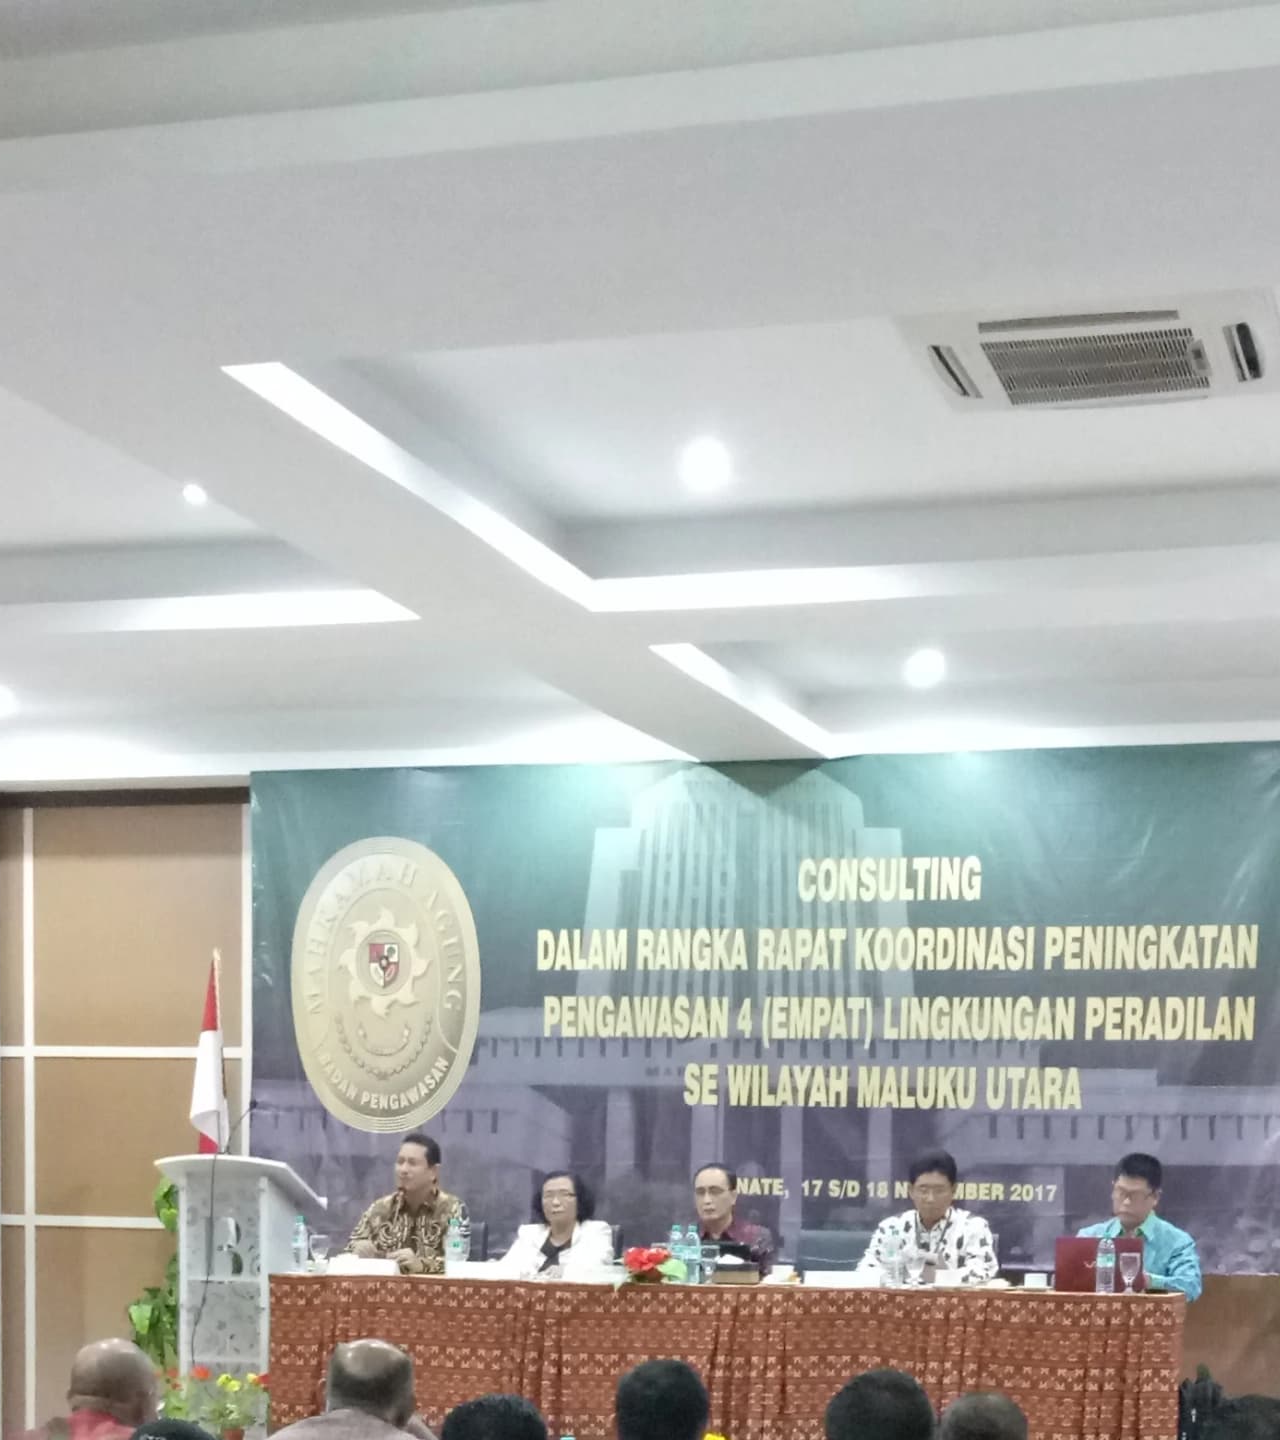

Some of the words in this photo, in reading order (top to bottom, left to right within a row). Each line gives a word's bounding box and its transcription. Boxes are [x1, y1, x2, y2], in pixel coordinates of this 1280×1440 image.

[797, 856, 982, 902] CONSULTING
[427, 889, 465, 1011] AGUNG
[537, 928, 628, 971] DALAM
[637, 928, 748, 971] RANGKA
[757, 928, 847, 971] RAPAT
[855, 926, 1036, 972] KOORDINASI
[1044, 924, 1259, 970] PENINGKATAN
[544, 995, 729, 1039] PENGAWASAN
[737, 997, 753, 1039] 4
[762, 996, 873, 1049] (EMPAT)
[883, 996, 1075, 1041] LINGKUNGAN
[1085, 996, 1255, 1041] PERADILAN
[318, 1053, 358, 1099] BADAN
[360, 1056, 450, 1111] PENGAWASAN
[683, 1063, 719, 1106] SE
[728, 1065, 849, 1107] WILAYAH
[858, 1065, 977, 1109] MALUKU
[986, 1066, 1082, 1110] UTARA
[735, 1177, 790, 1199] NATE,
[801, 1179, 823, 1197] 17
[828, 1179, 861, 1200] S/D
[866, 1181, 889, 1199] 18
[1010, 1183, 1057, 1202] 2017
